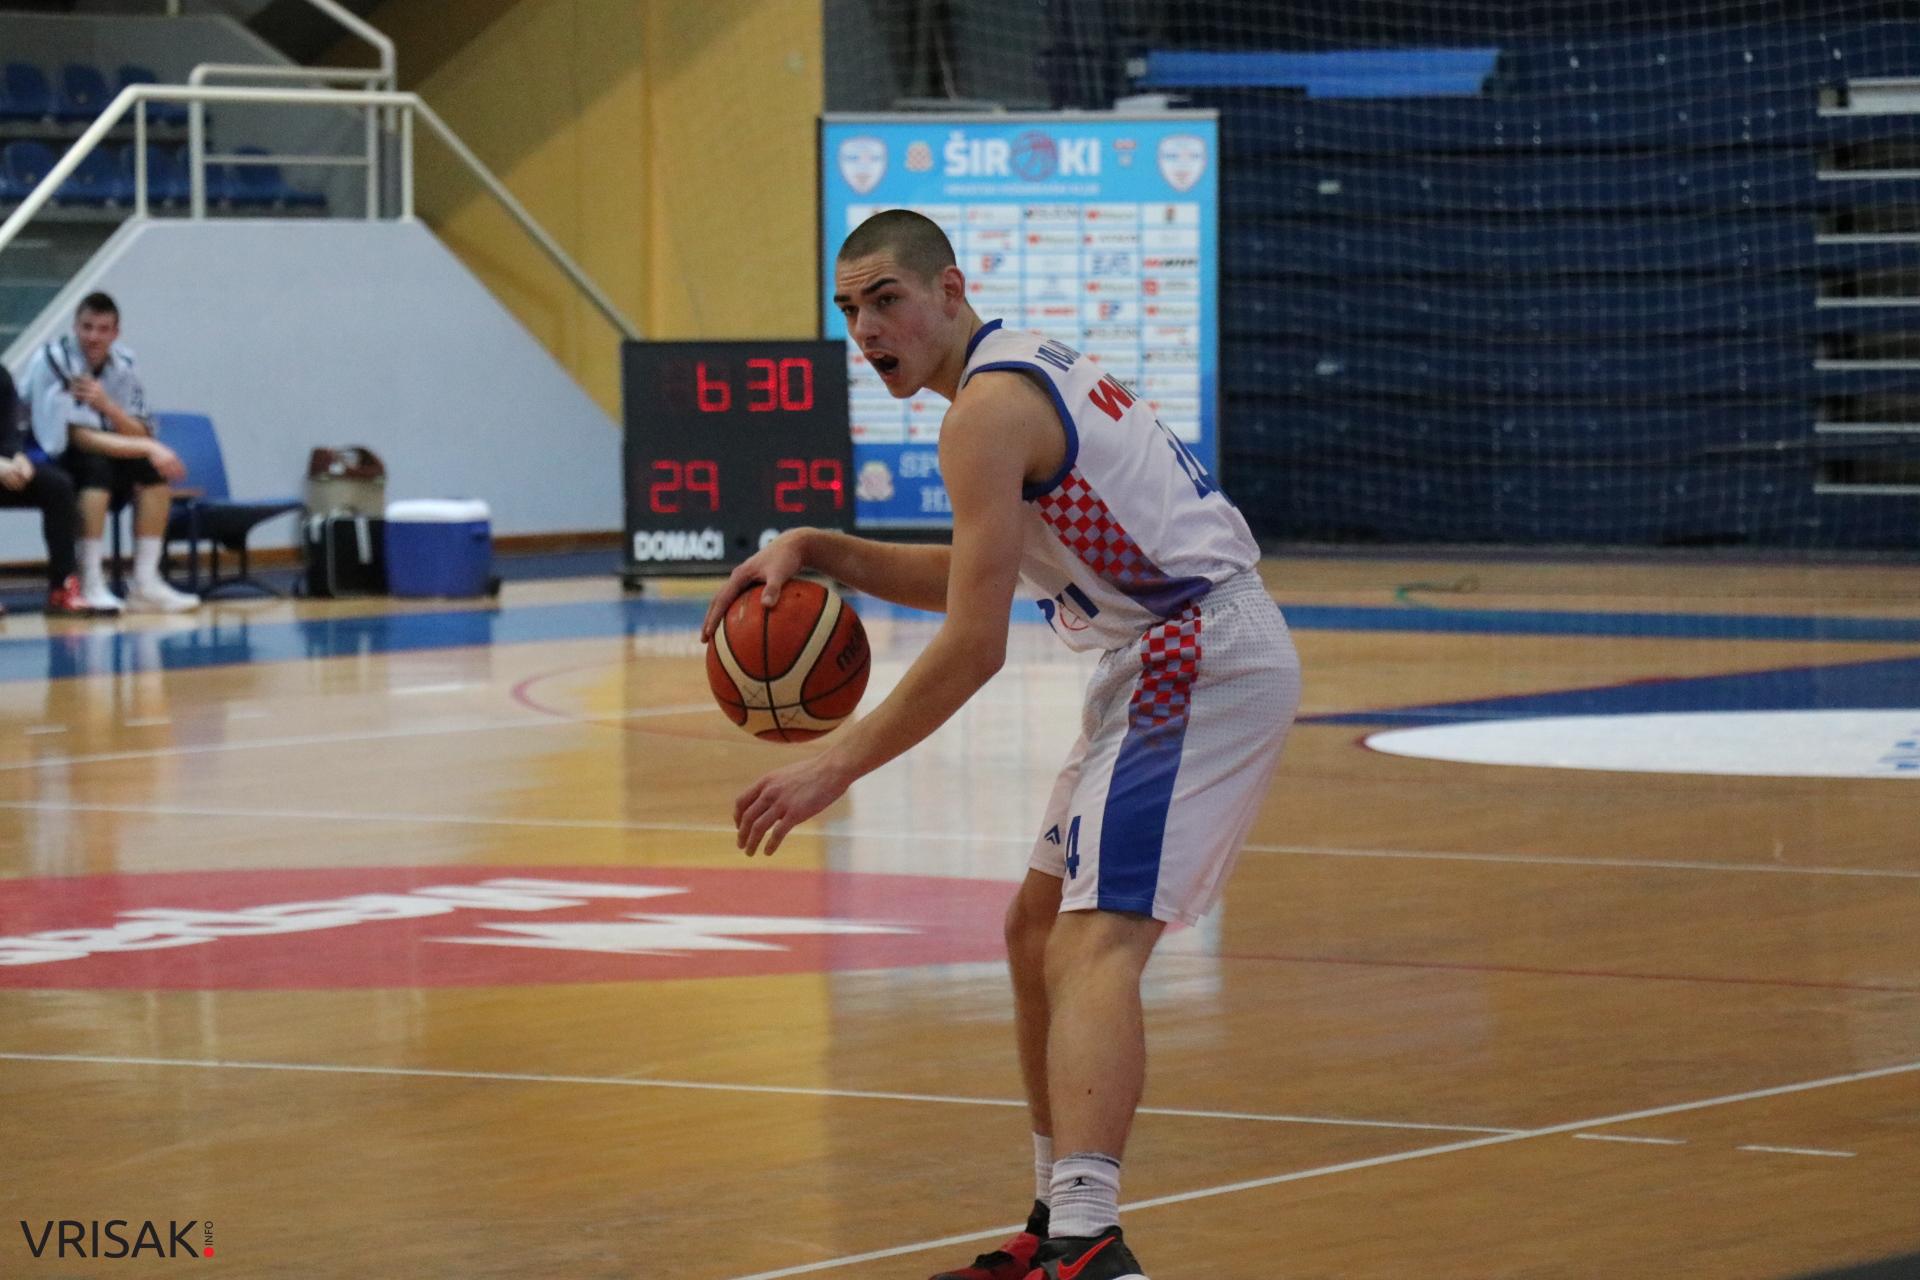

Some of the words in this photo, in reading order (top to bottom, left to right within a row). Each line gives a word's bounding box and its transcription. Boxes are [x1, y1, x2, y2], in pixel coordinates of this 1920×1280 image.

[746, 357, 814, 412] 30
[650, 459, 720, 513] 29
[774, 458, 844, 513] 29
